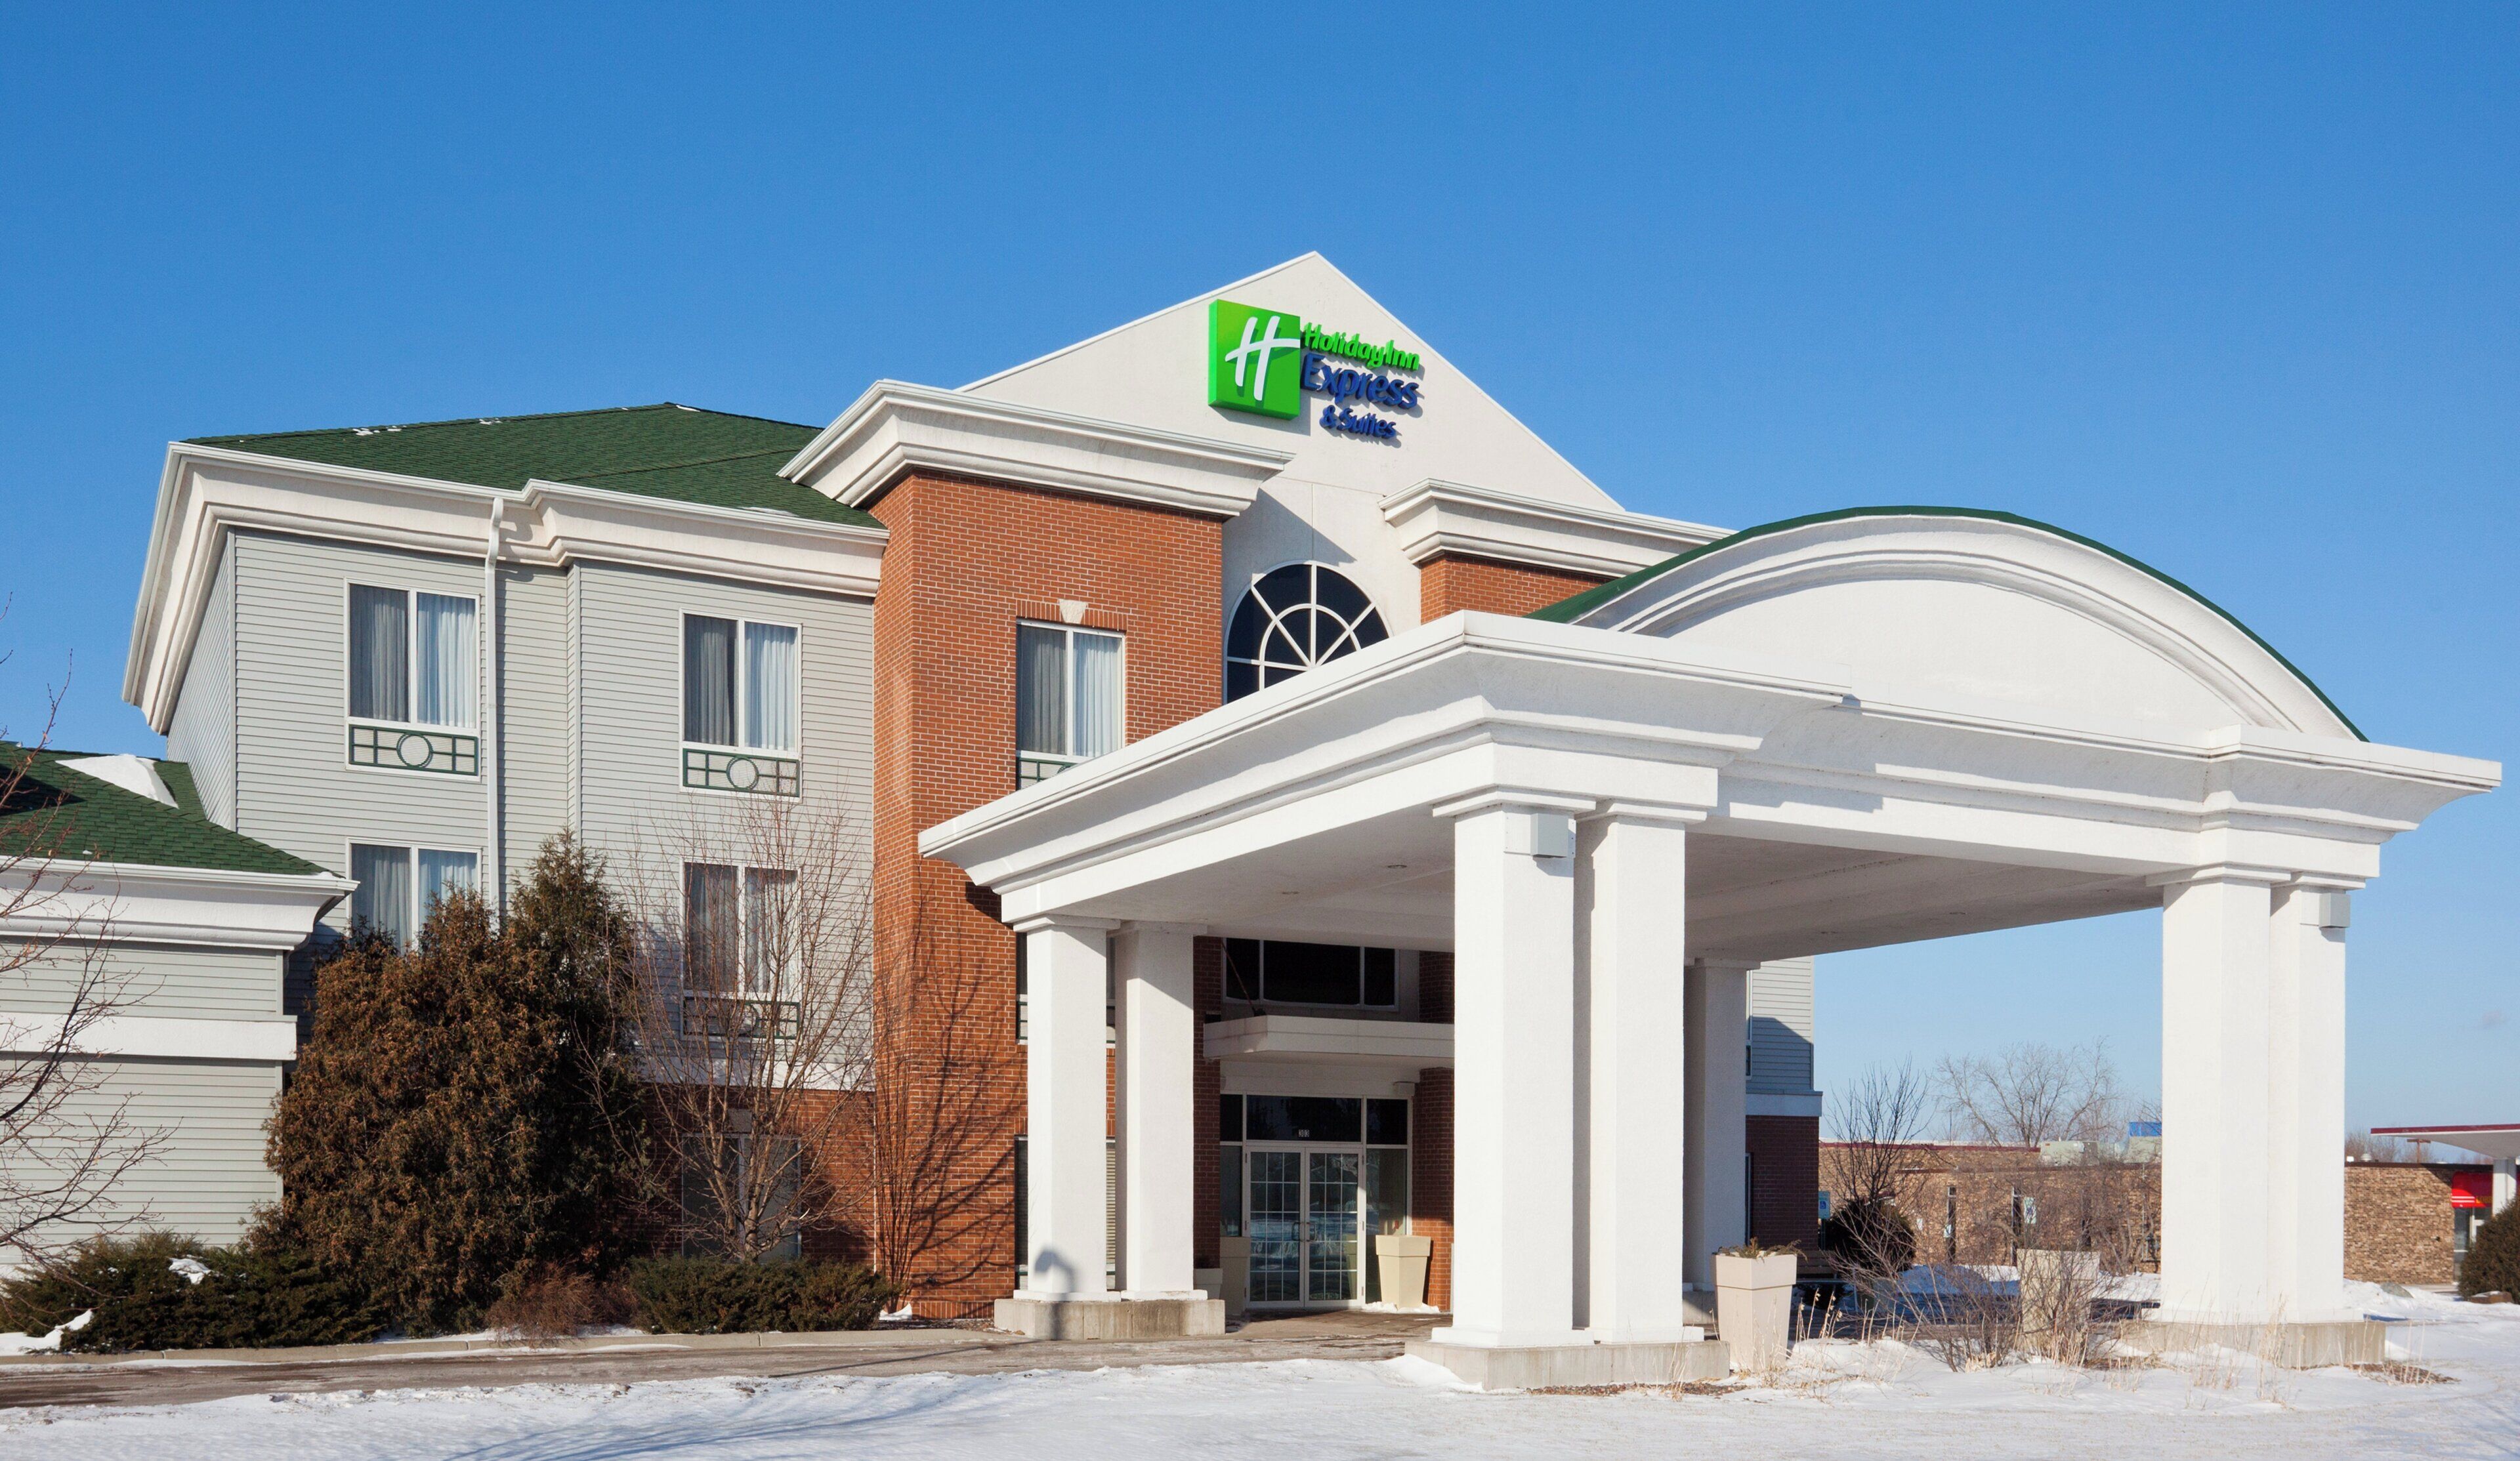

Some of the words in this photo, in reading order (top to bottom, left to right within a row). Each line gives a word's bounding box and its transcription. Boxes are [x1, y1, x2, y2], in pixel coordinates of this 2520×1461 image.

[1301, 352, 1419, 409] Express
[1320, 405, 1337, 428] &
[1337, 407, 1396, 439] Suites
